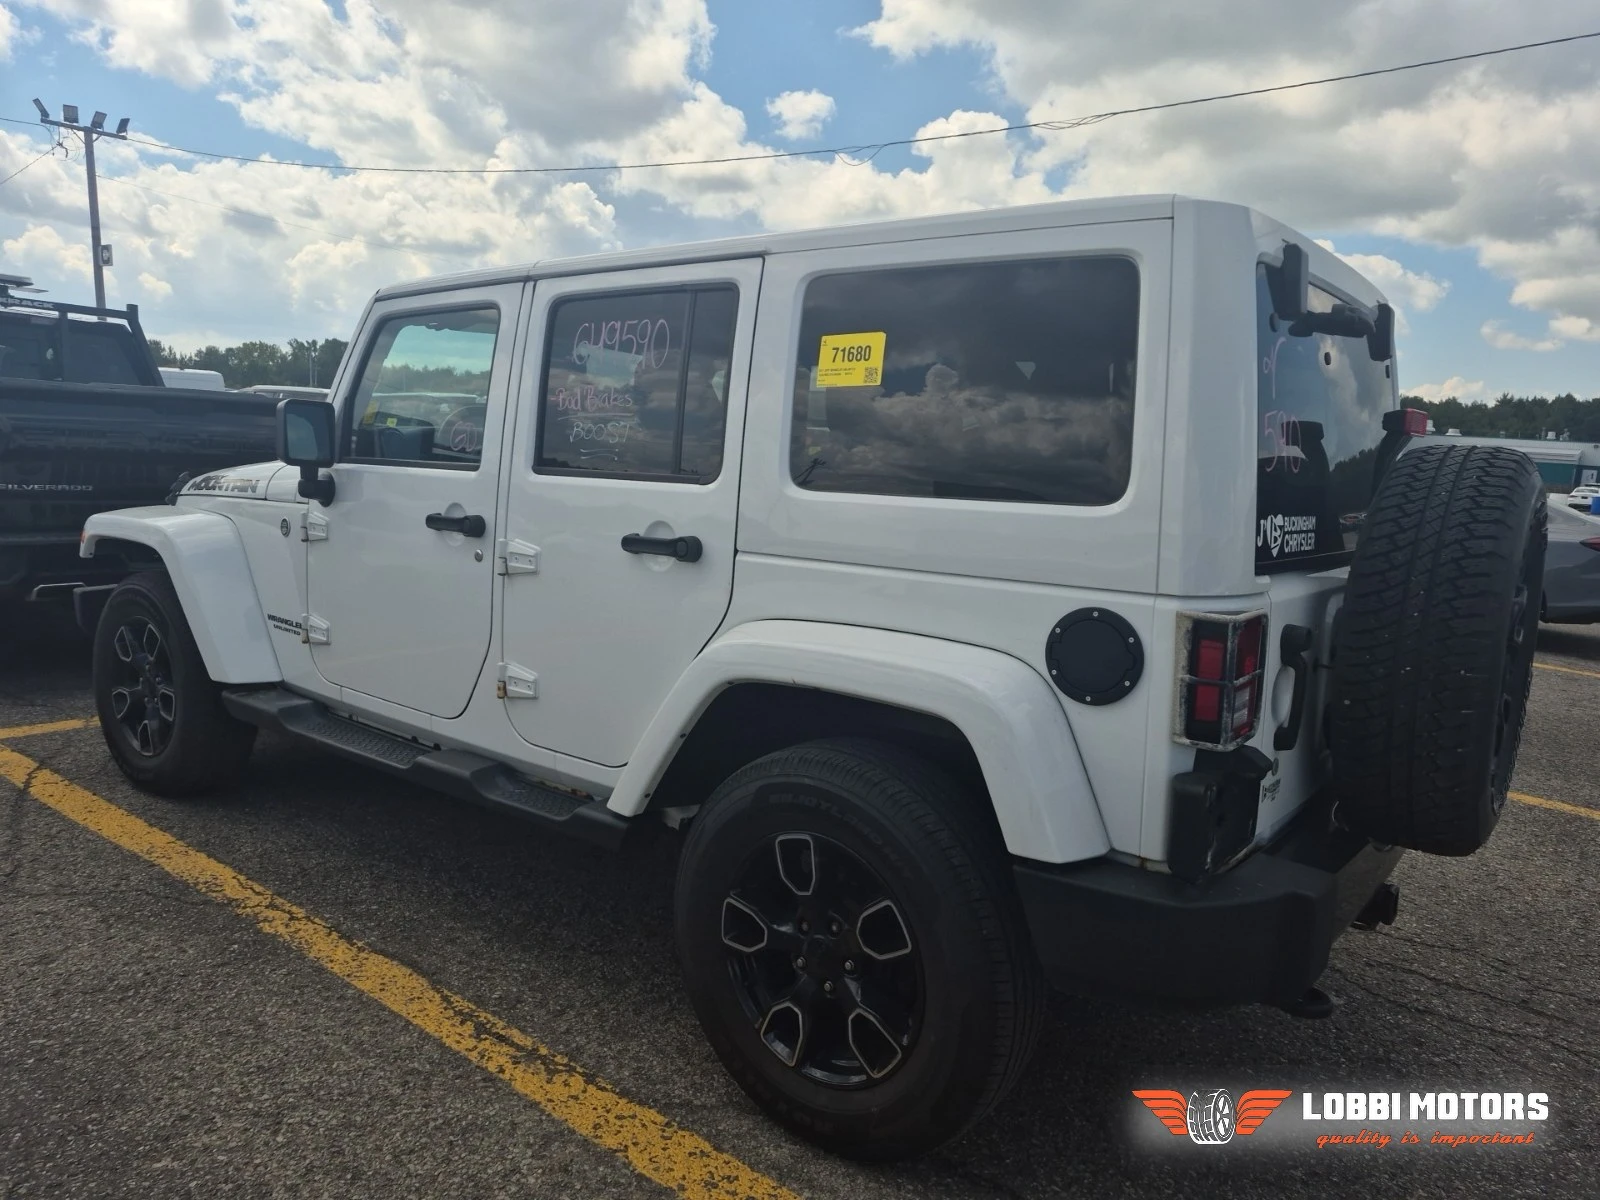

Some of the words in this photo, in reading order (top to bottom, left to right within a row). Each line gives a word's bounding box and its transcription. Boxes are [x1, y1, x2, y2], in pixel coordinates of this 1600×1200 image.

[831, 345, 872, 363] 71680
[0, 483, 94, 491] SILVERADO
[1284, 515, 1316, 532] BUCKINGHAM
[1284, 532, 1316, 553] CHRYSLER
[273, 624, 301, 636] UNLIMITED
